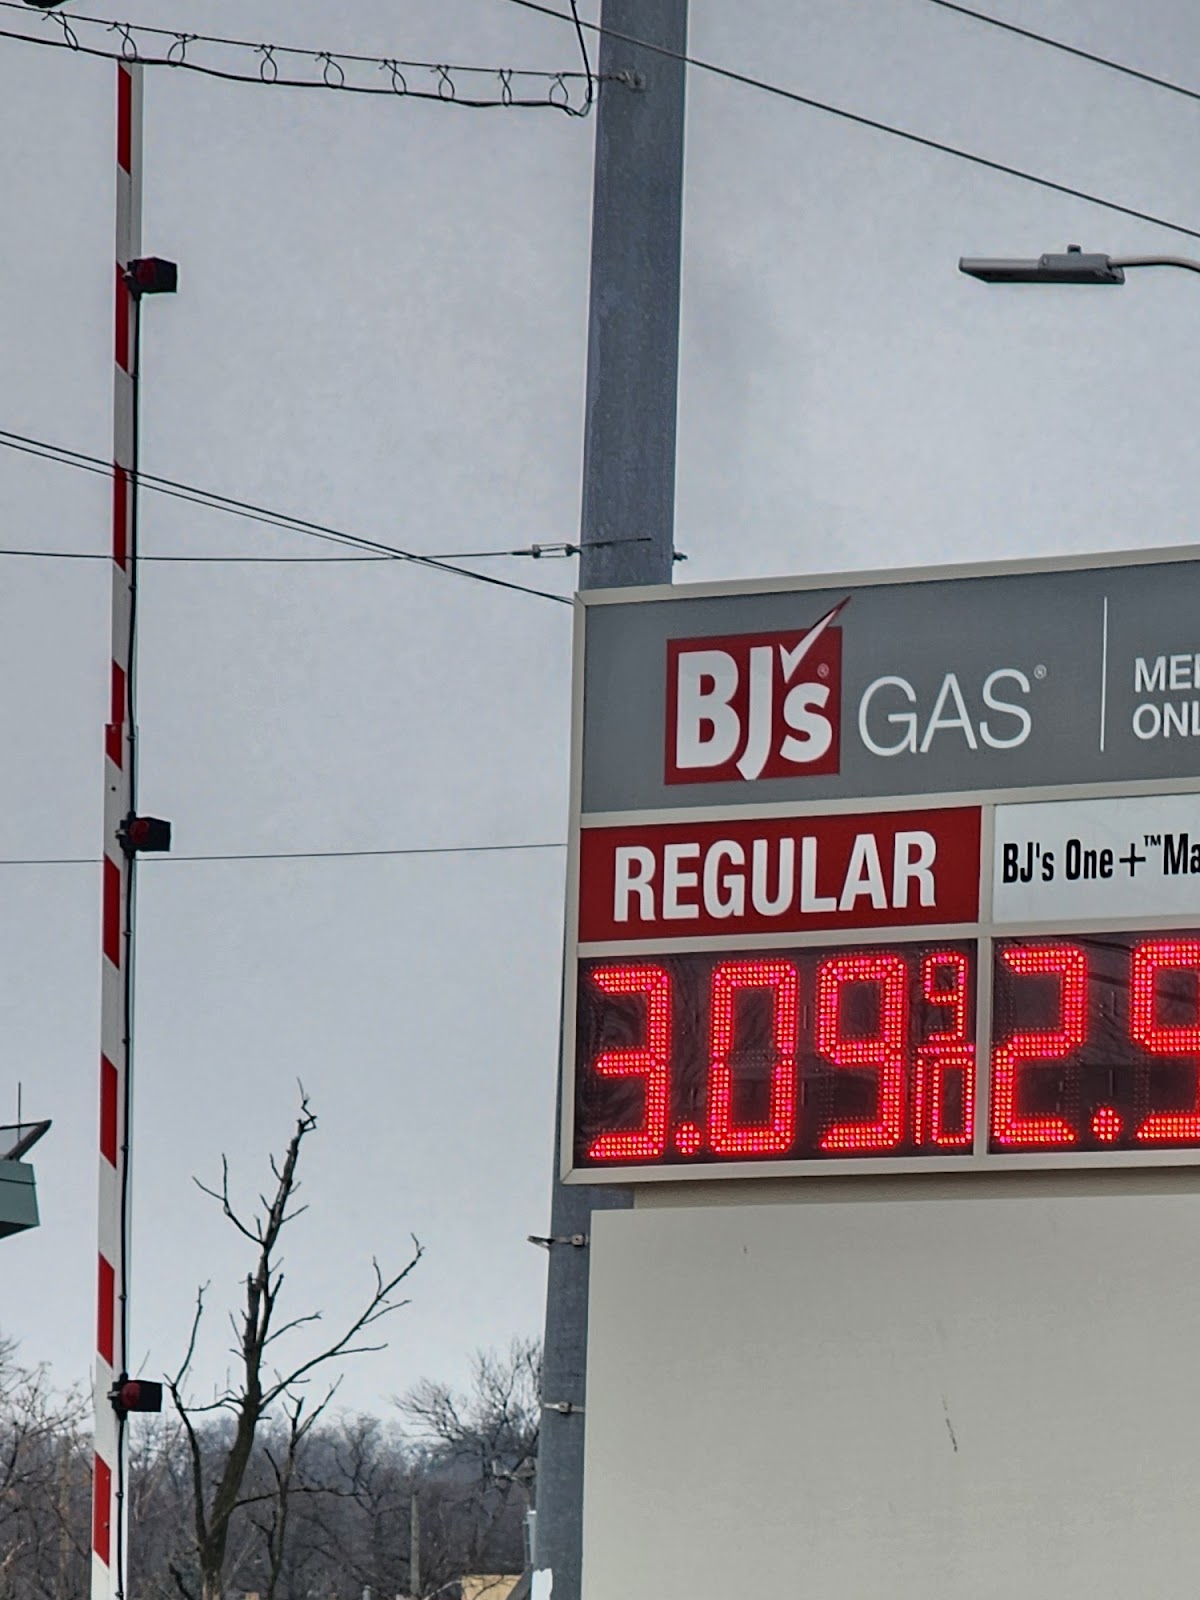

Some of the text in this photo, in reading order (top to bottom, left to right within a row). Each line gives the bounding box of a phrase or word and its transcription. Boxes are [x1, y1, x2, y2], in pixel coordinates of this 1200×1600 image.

[613, 830, 937, 923] REGULAR
[1002, 841, 1055, 884] BJ's
[587, 952, 905, 1161] 3.09
